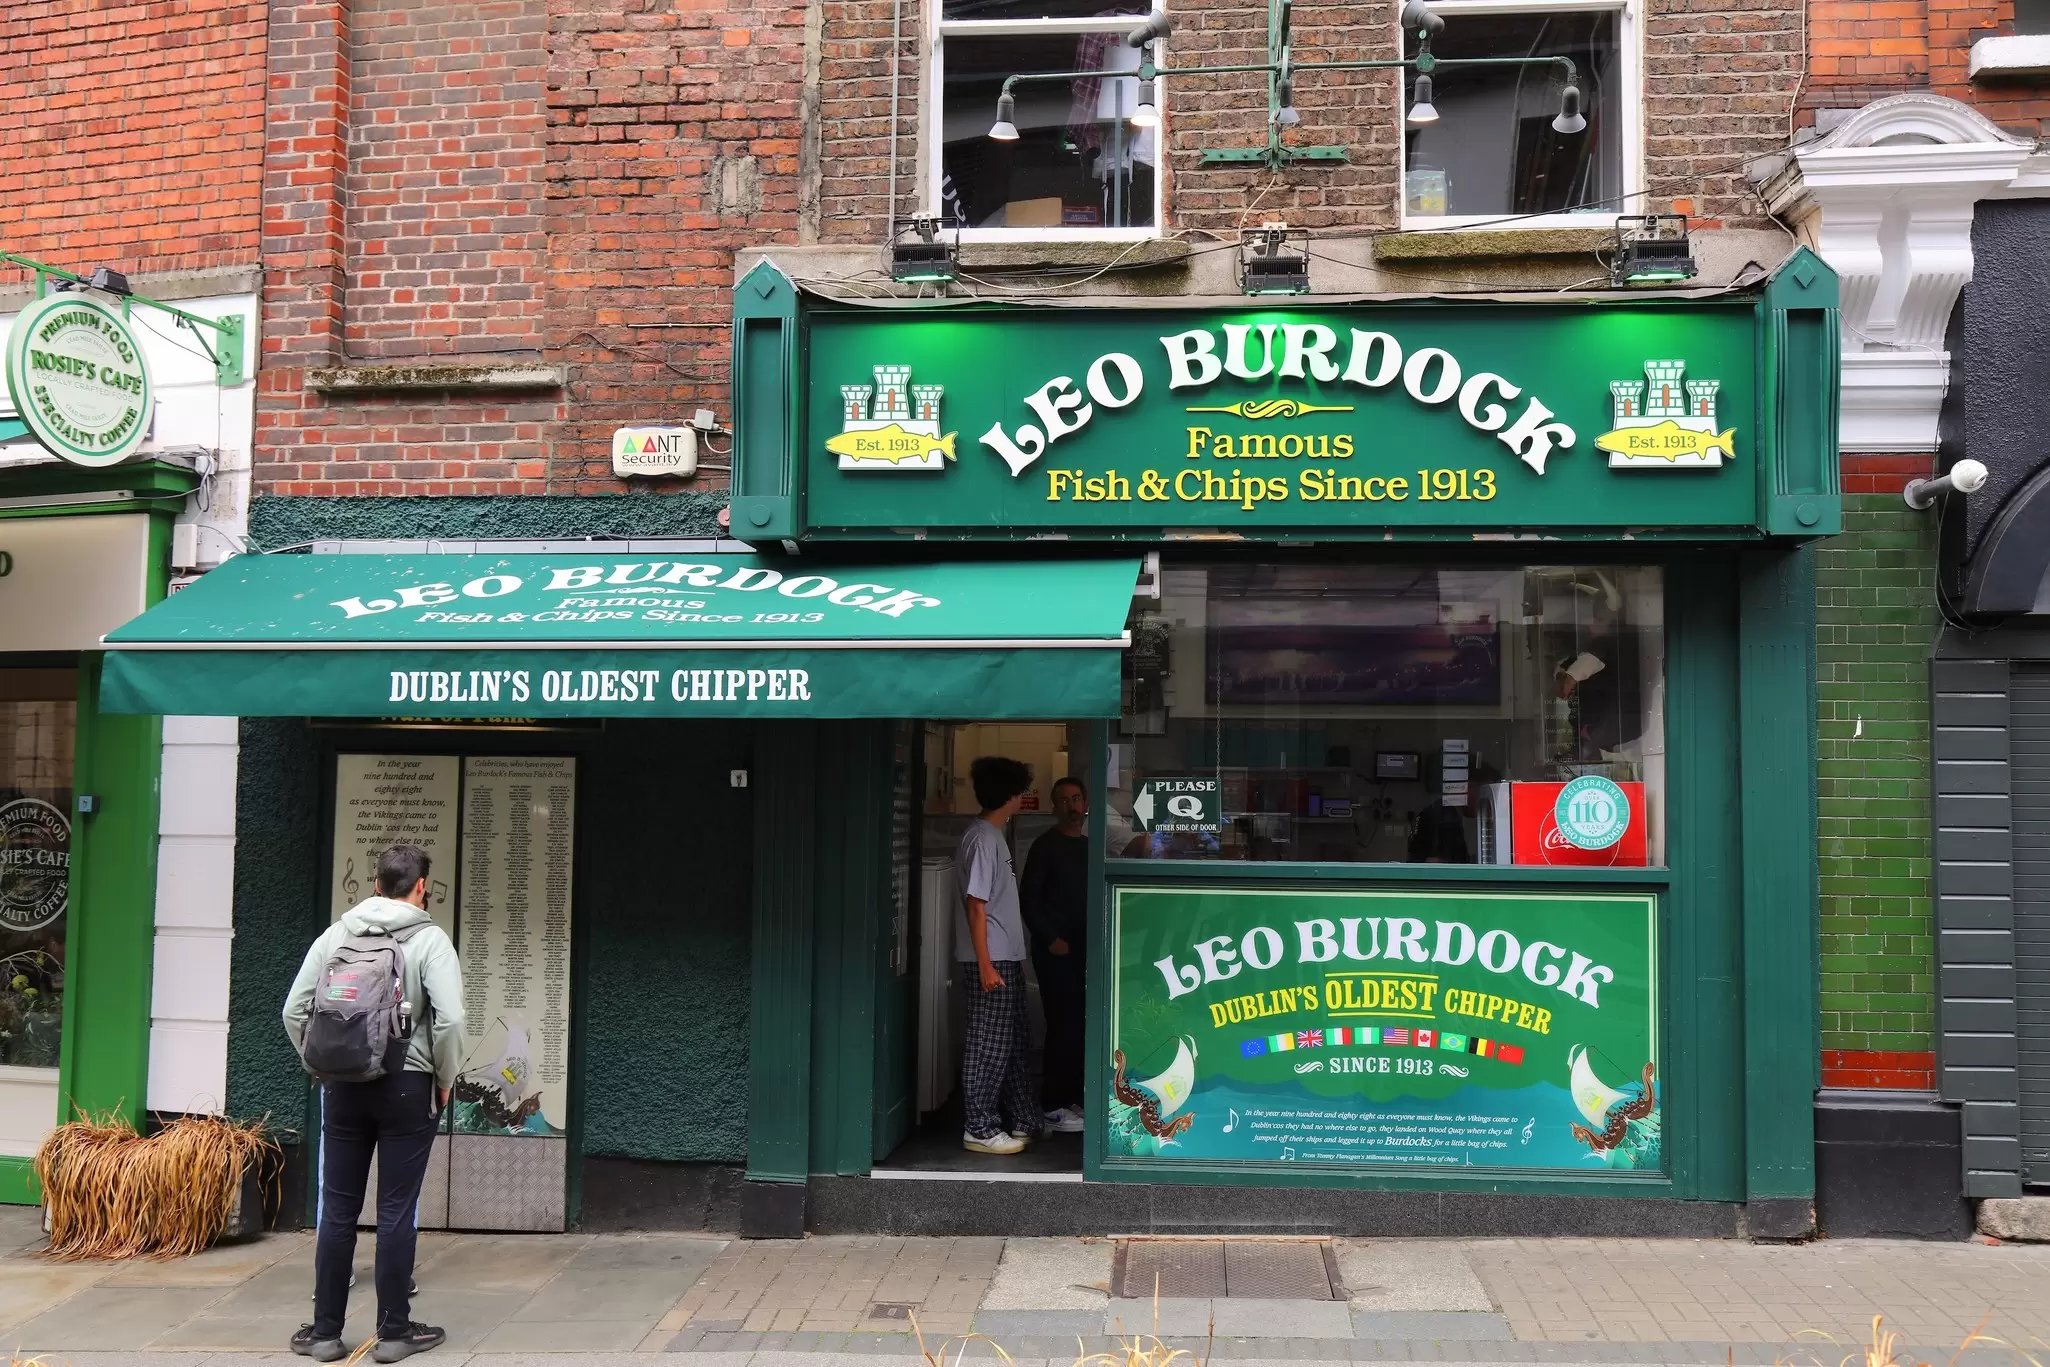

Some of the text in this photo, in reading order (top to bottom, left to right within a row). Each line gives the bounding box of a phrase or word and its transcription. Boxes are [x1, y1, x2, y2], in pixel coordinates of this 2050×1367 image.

[39, 311, 100, 343] PREMIUM
[102, 321, 135, 364] FOOD
[31, 349, 142, 396] ROSIE'S CAFÉ
[978, 321, 1577, 477] LEO BURDOCK
[34, 385, 138, 448] SPECIALTY COFFEE
[855, 436, 920, 452] Est. 1913
[1186, 426, 1354, 460] Famous
[1628, 434, 1697, 449] Est. 1913
[1046, 468, 1497, 510] Fish & Chips Since 1913
[330, 561, 941, 619] LEO BURDOCK
[554, 597, 707, 611] Famous
[416, 609, 826, 626] Fish & Chips Since 1913
[389, 669, 812, 703] DUBLIN'S OLDEST CHIPPER
[387, 760, 401, 768] the
[401, 761, 421, 769] year
[383, 772, 416, 780] hundred
[374, 785, 423, 795] eighty eight
[1155, 781, 1217, 792] PLEASE
[1563, 779, 1621, 800] CELEBRATING
[361, 799, 397, 807] everyone
[421, 799, 446, 807] know,
[1167, 795, 1205, 820] Q
[1572, 800, 1613, 823] 110
[373, 811, 403, 820] Vikings
[40, 811, 67, 842] FOOD
[355, 823, 382, 831] Dublin
[402, 824, 421, 833] they
[422, 824, 439, 832] had
[1155, 823, 1217, 831] OTHER SIDE OF DOOR
[1561, 821, 1626, 846] LEO BURDOCK
[369, 837, 394, 845] where
[395, 837, 411, 845] else
[413, 837, 422, 845] to
[33, 879, 69, 920] COFFEE
[1153, 916, 1615, 1009] LEO BURDOCK
[1208, 977, 1553, 1035] DUBLIN'S OLDEST CHIPPER
[1330, 1057, 1435, 1076] SINCE 1913
[1295, 1110, 1323, 1118] hundred
[1337, 1111, 1358, 1120] eighty
[1359, 1112, 1375, 1120] eight
[1467, 1115, 1491, 1123] Vikings
[1285, 1122, 1299, 1130] they
[1300, 1122, 1313, 1130] had
[1324, 1123, 1344, 1131] where
[1379, 1125, 1394, 1133] they
[1395, 1125, 1416, 1133] landed
[1447, 1126, 1466, 1135] Quay
[1487, 1127, 1502, 1136] they
[1252, 1134, 1278, 1142] jumped
[1278, 1135, 1289, 1144] off
[1337, 1137, 1359, 1145] legged
[1384, 1136, 1433, 1147] Burdocks
[1432, 1139, 1444, 1148] for
[1451, 1139, 1466, 1147] little
[1467, 1140, 1480, 1149] bag
[1480, 1140, 1489, 1149] of
